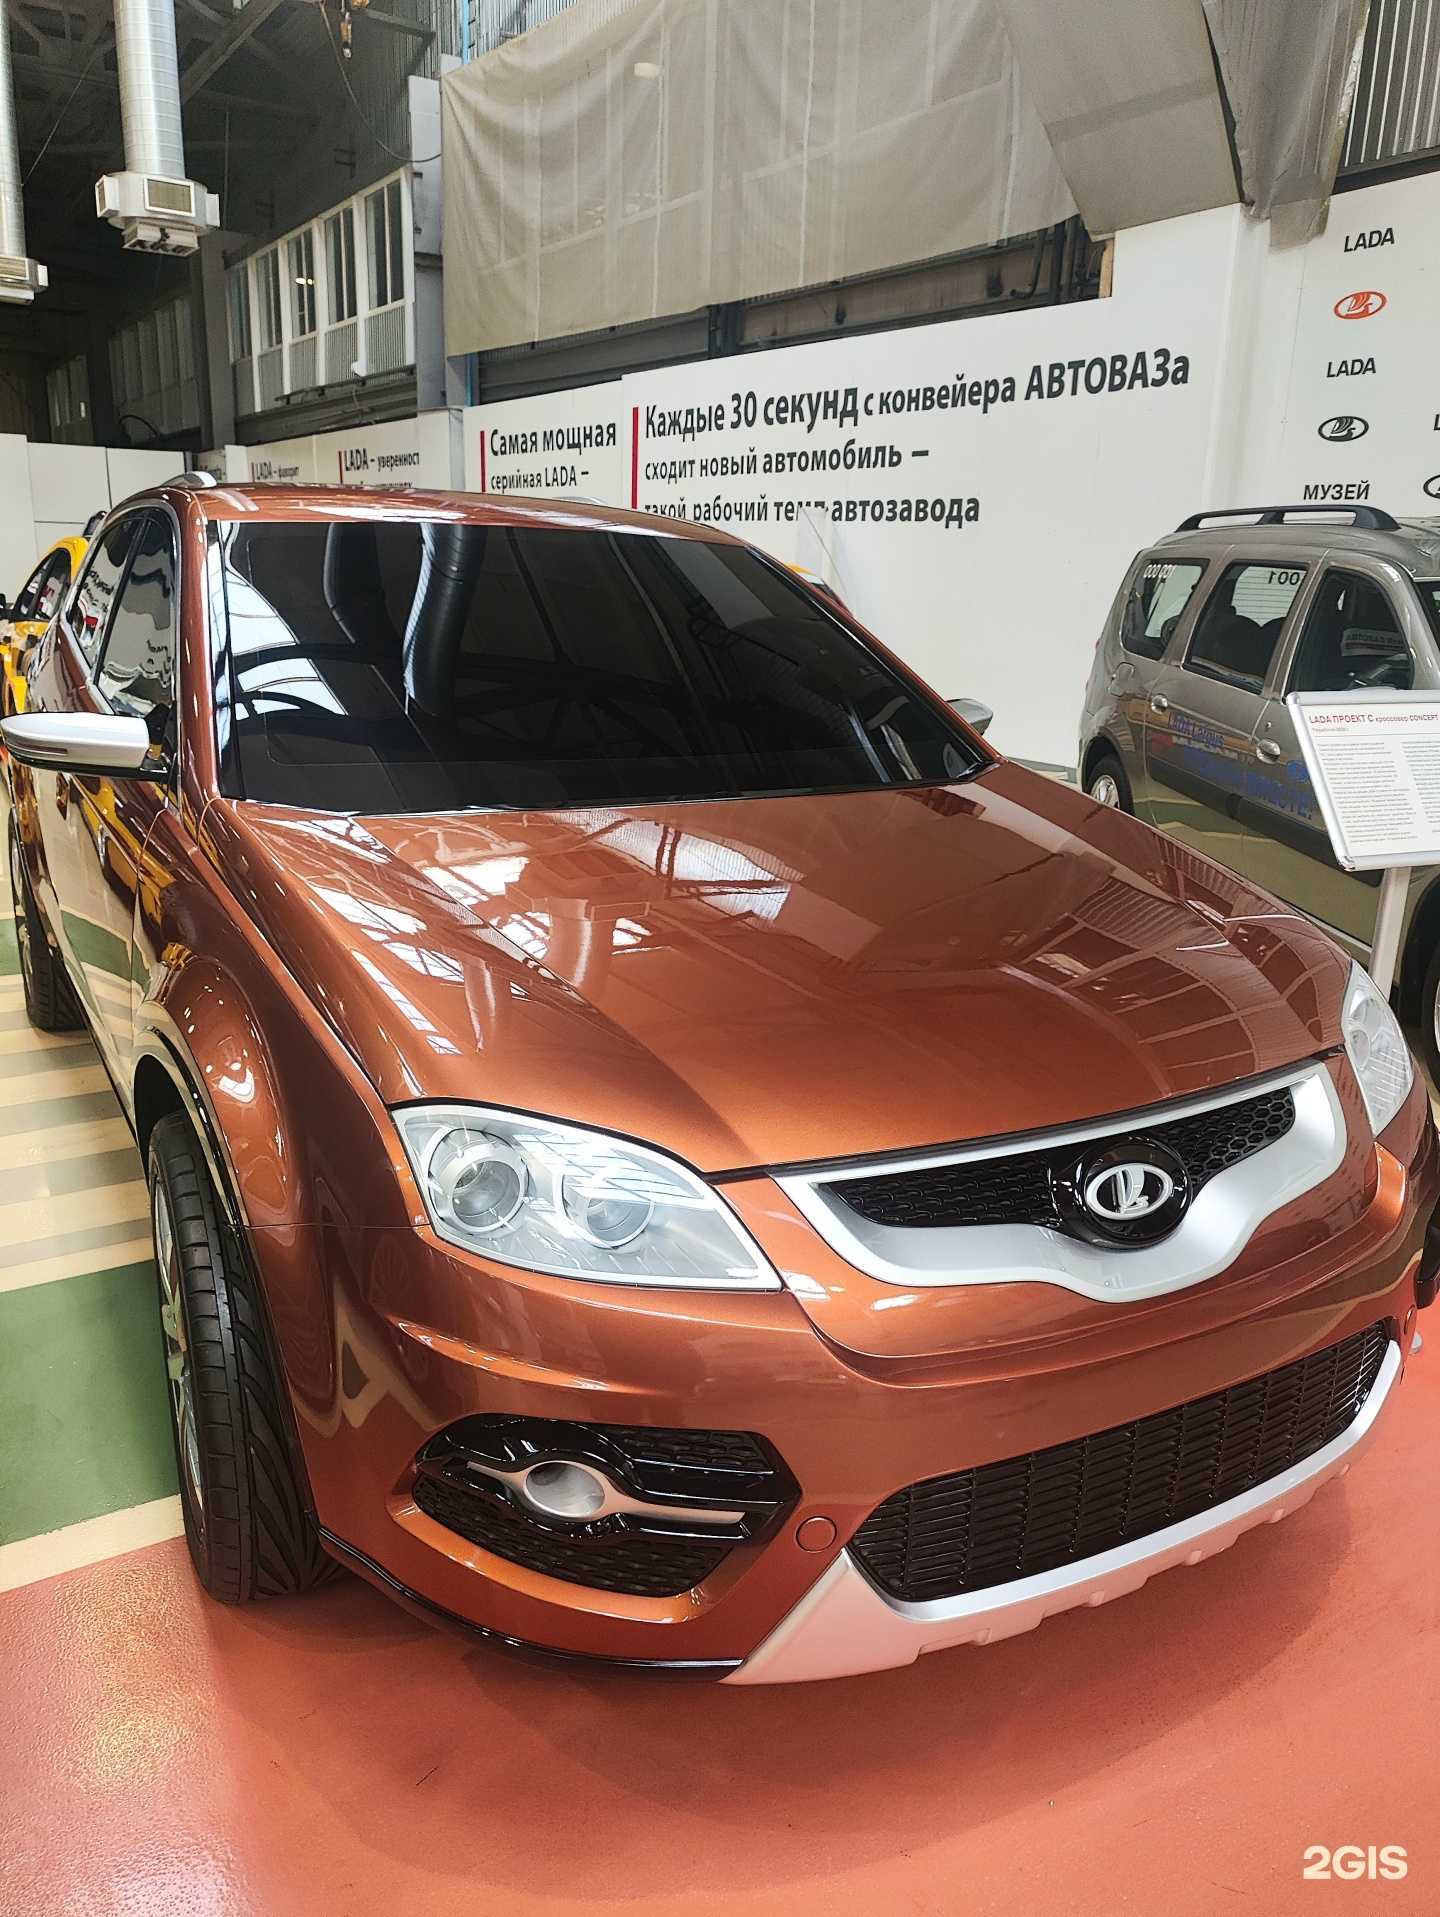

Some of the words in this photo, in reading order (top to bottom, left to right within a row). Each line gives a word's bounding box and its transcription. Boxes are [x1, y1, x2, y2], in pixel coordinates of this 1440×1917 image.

[1343, 227, 1395, 253] LADA
[1326, 357, 1376, 378] LADA
[645, 401, 725, 443] Каждые
[730, 393, 758, 429] 30
[762, 386, 860, 434] секунд
[863, 395, 875, 416] с
[879, 374, 1017, 416] конвейера
[1024, 347, 1190, 401] АВТОВАЗа
[490, 427, 538, 458] Самая
[542, 420, 617, 453] мощная
[344, 447, 369, 471] LADA
[645, 458, 696, 485] сходит
[699, 447, 758, 479] новый
[762, 437, 903, 474] автомобиль
[490, 473, 541, 494] серийная
[544, 465, 578, 487] LADA
[1303, 480, 1370, 501] МУЗЕЙ
[693, 493, 768, 522] рабочий
[831, 495, 980, 528] автозавода
[1309, 714, 1330, 724] LADA
